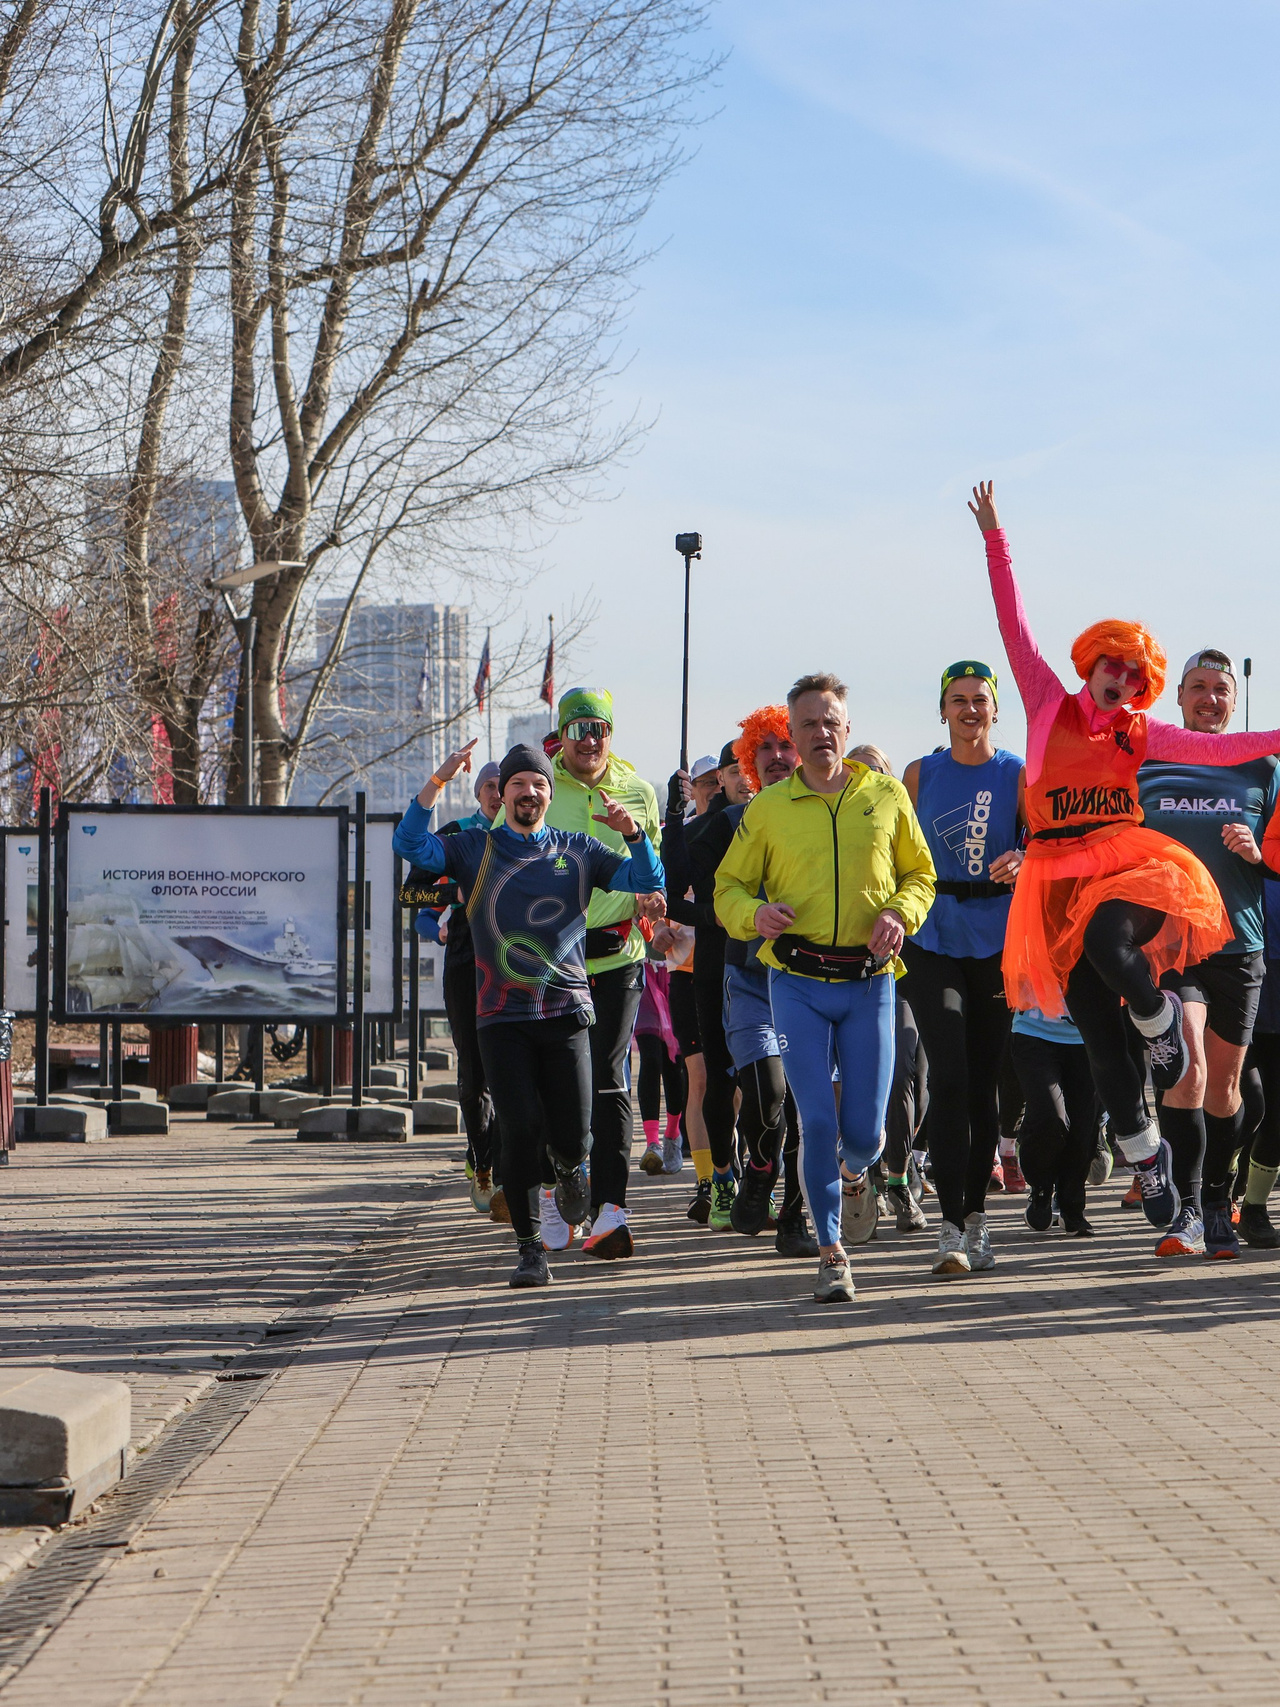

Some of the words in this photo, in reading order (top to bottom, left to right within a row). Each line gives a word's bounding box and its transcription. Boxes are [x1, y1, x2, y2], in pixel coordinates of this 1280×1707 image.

[1160, 798, 1242, 811] BAIKAL
[966, 790, 992, 876] adidas
[103, 870, 164, 881] ИСТОРИЯ
[169, 870, 305, 882] ВОЕННО-МОРСКОГО
[151, 885, 198, 896] ФЛОТА
[202, 886, 256, 897] РОССИИ
